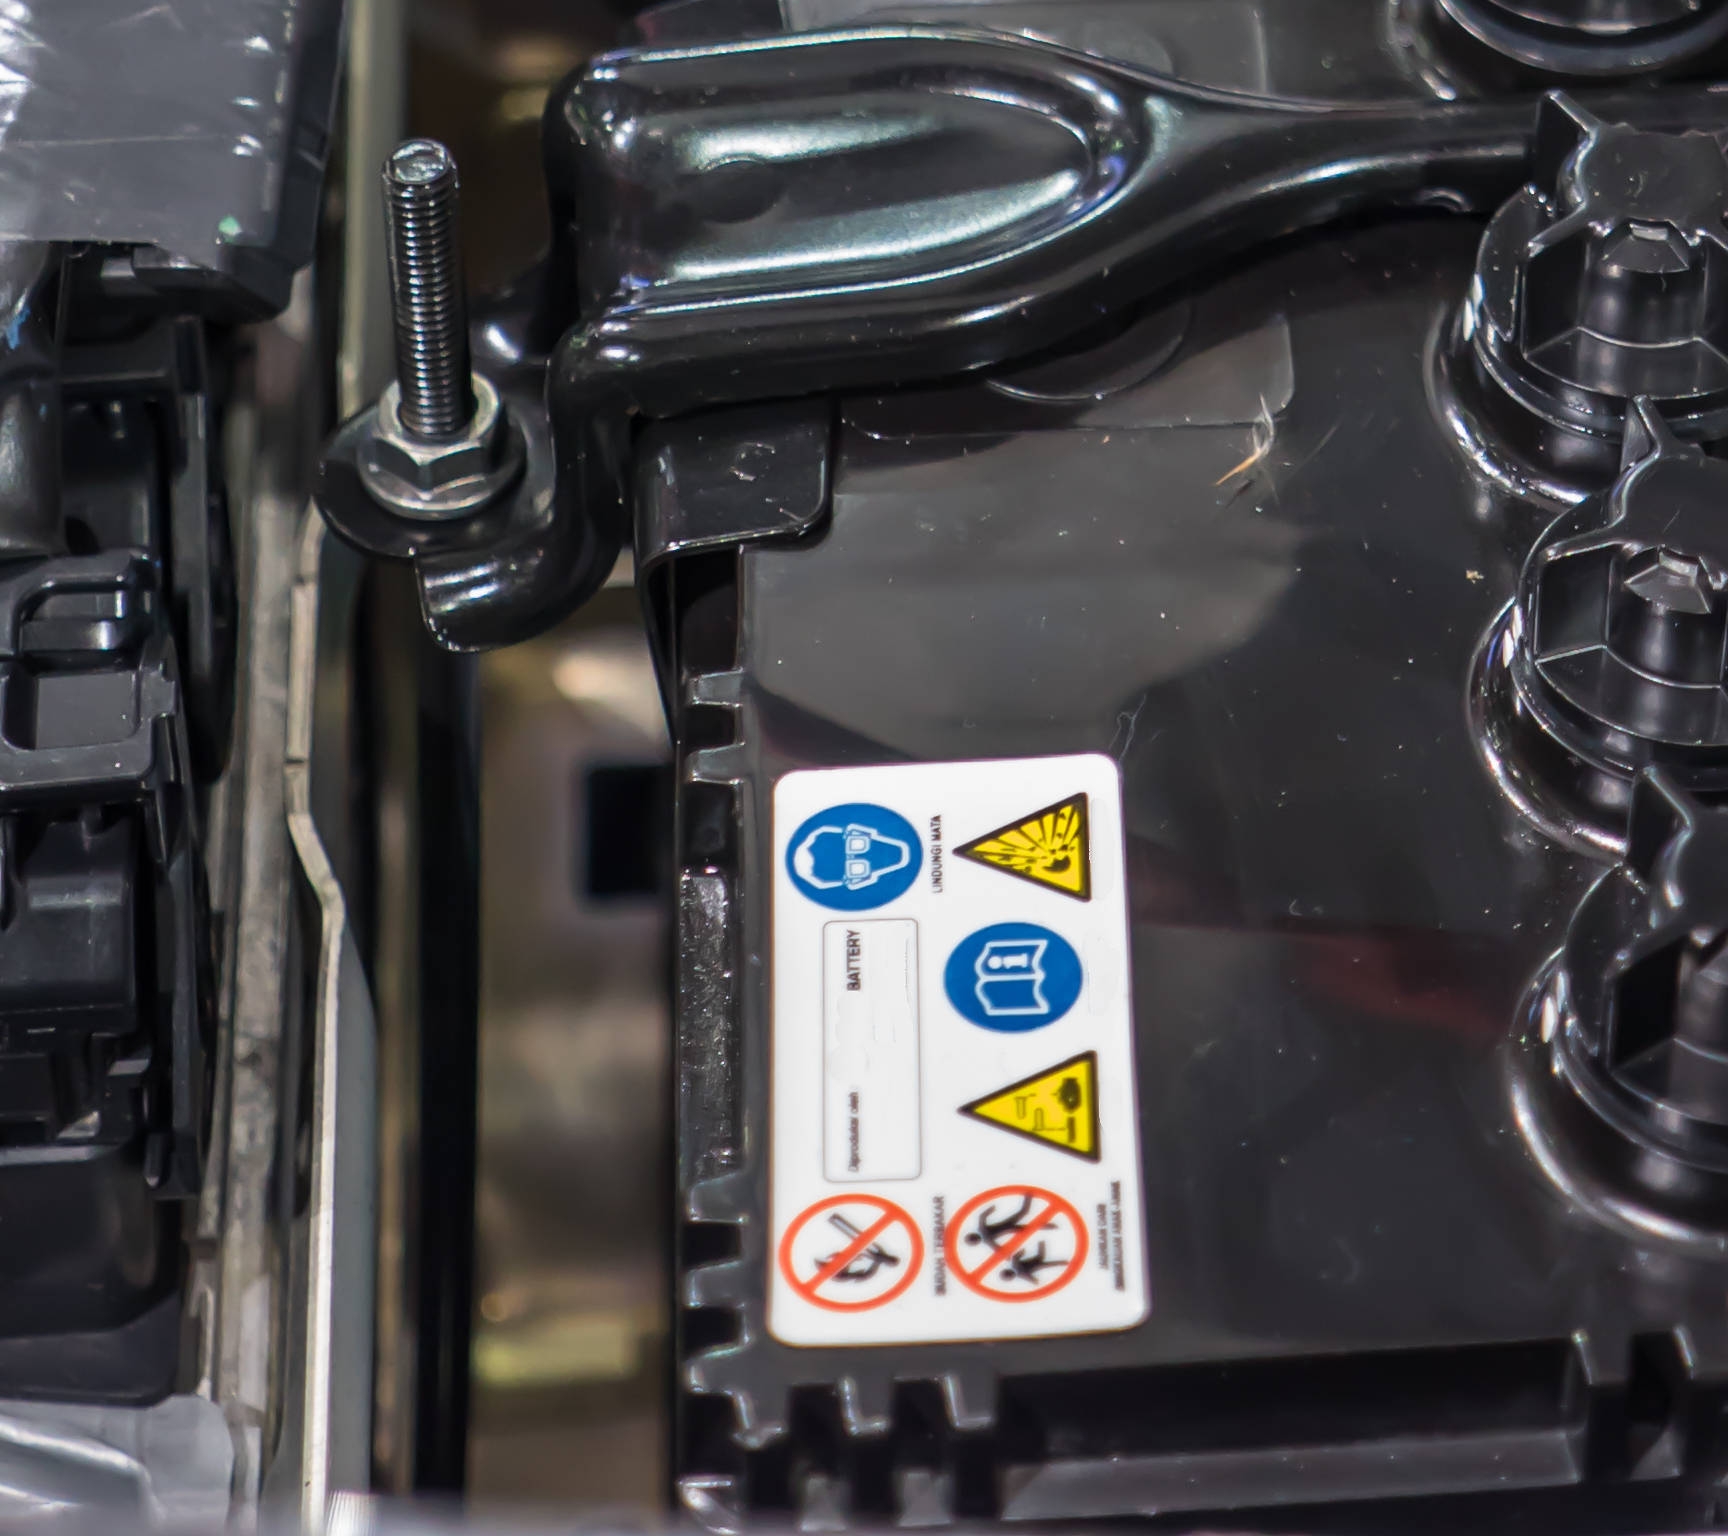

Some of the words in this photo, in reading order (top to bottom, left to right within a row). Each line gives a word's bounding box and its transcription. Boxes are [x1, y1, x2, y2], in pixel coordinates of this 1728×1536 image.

[929, 814, 942, 841] MATA
[930, 843, 943, 894] LINDUNGI
[846, 929, 861, 992] BATTERY
